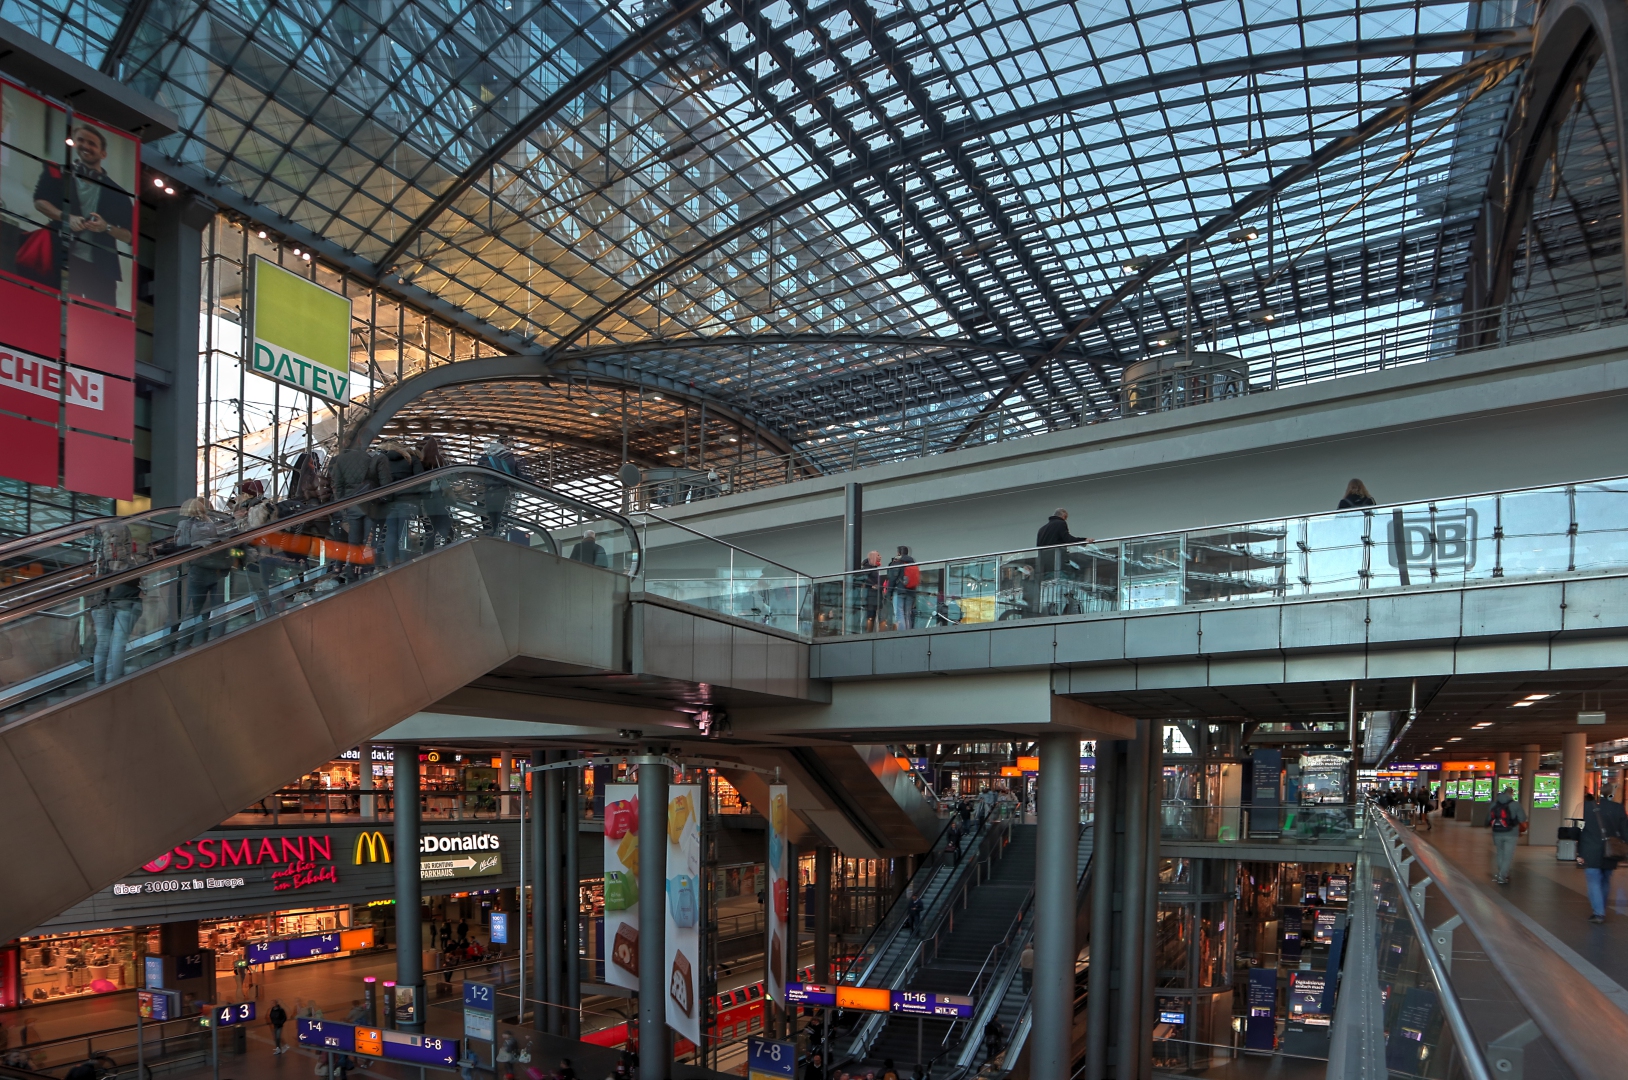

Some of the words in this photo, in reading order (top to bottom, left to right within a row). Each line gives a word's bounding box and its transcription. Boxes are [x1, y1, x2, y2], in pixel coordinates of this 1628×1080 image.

[0, 351, 99, 403] CHEN:
[254, 342, 348, 401] DATEV
[1404, 523, 1469, 562] DB
[420, 834, 500, 853] Donald's
[141, 835, 332, 873] SSMANN
[293, 865, 338, 889] Bahnhof
[420, 869, 455, 879] PARKHAUS.
[113, 883, 142, 895] über
[145, 880, 179, 893] 3000
[181, 881, 191, 891] x
[192, 878, 204, 890] in
[206, 877, 245, 889] Europa
[256, 942, 268, 951] 1-2
[321, 935, 332, 943] 1-4
[185, 954, 201, 965] 1-2
[472, 985, 489, 1000] 1-2
[903, 992, 926, 1003] 11-16
[221, 1007, 231, 1022] 4
[239, 1003, 250, 1019] 3
[308, 1020, 323, 1032] 1-4
[424, 1037, 442, 1050] 5-8
[754, 1040, 782, 1062] 7-8
